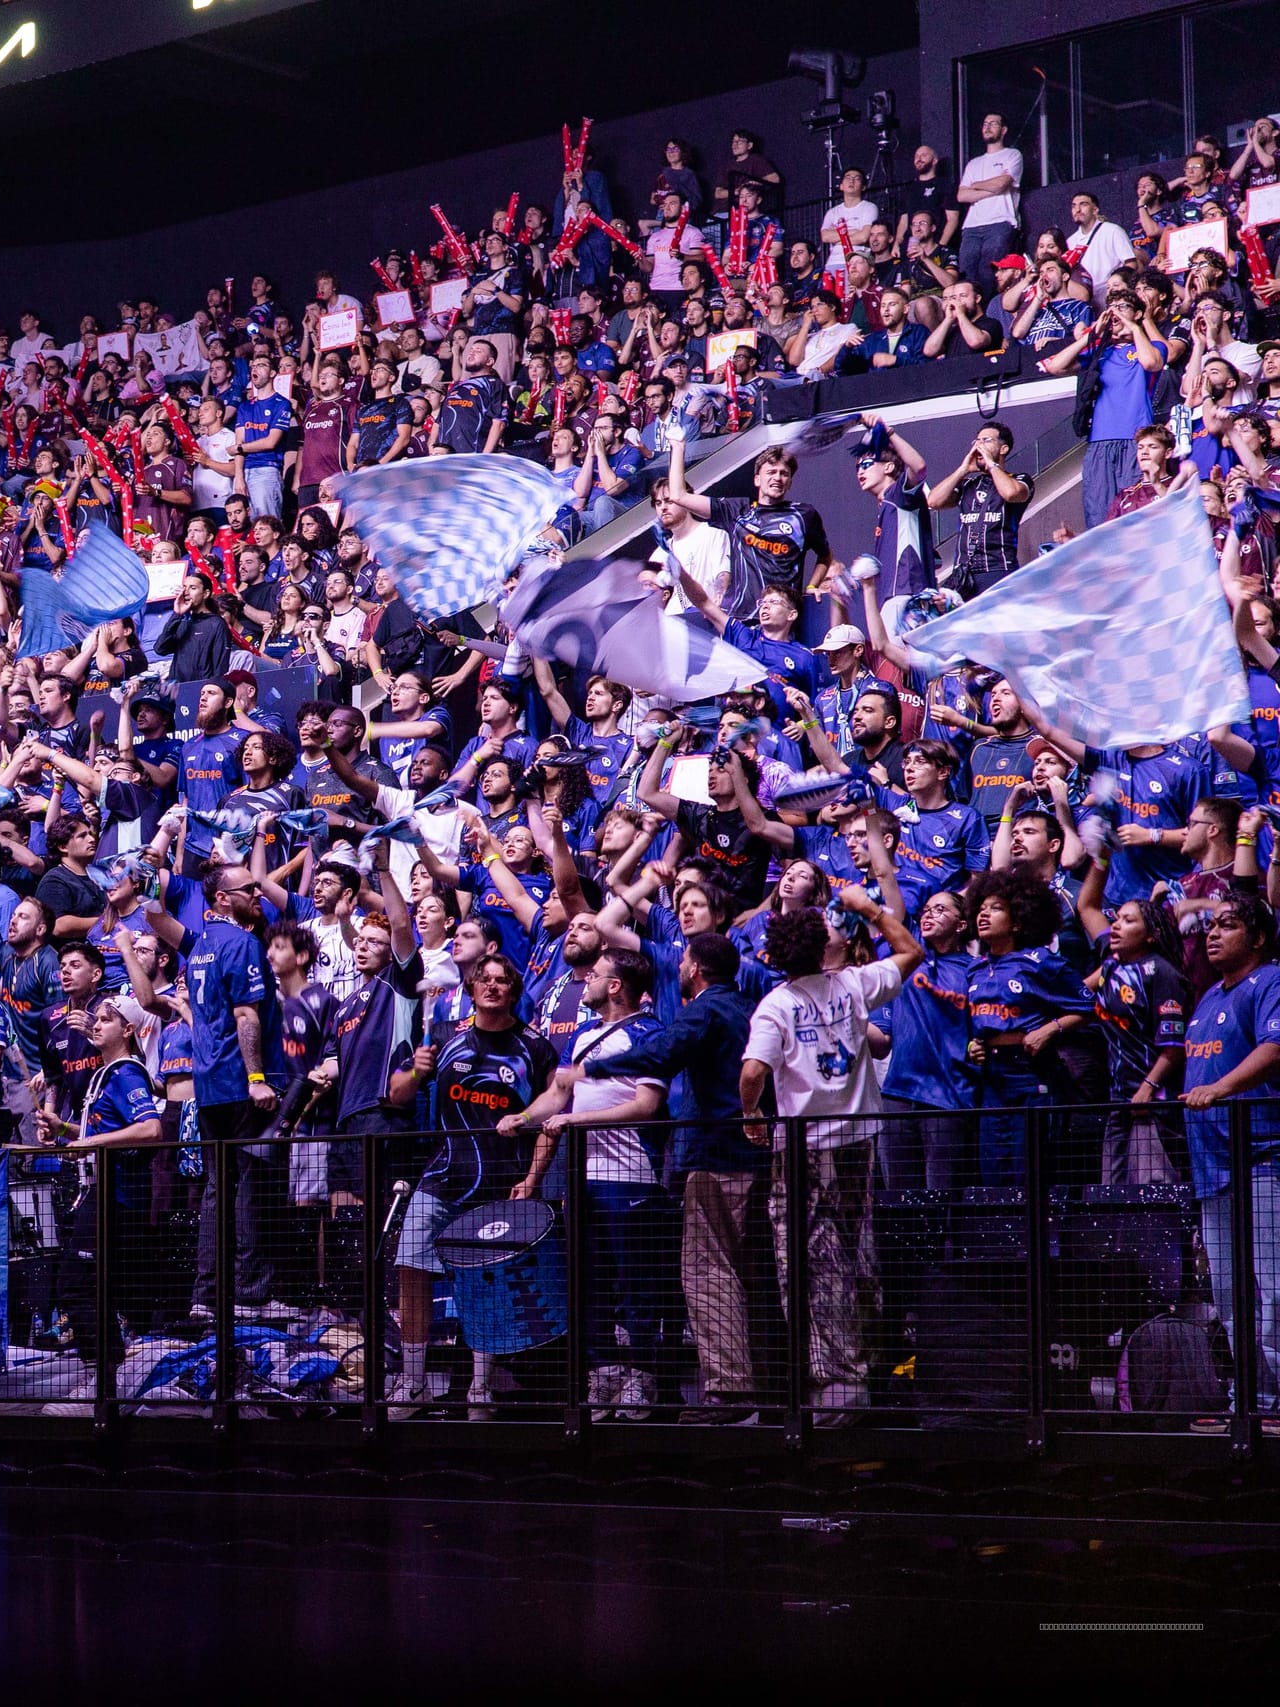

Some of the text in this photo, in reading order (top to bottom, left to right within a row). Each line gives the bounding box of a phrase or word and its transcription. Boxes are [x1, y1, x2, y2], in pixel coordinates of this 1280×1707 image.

[306, 420, 333, 430] Orange
[745, 534, 789, 555] Orange
[186, 768, 222, 780] Orange
[973, 774, 1026, 788] Orange
[313, 793, 351, 806] Orange
[194, 970, 205, 1004] 7
[1162, 1022, 1183, 1034] CIC
[63, 1056, 103, 1073] Orange
[450, 1083, 509, 1110] Orange
